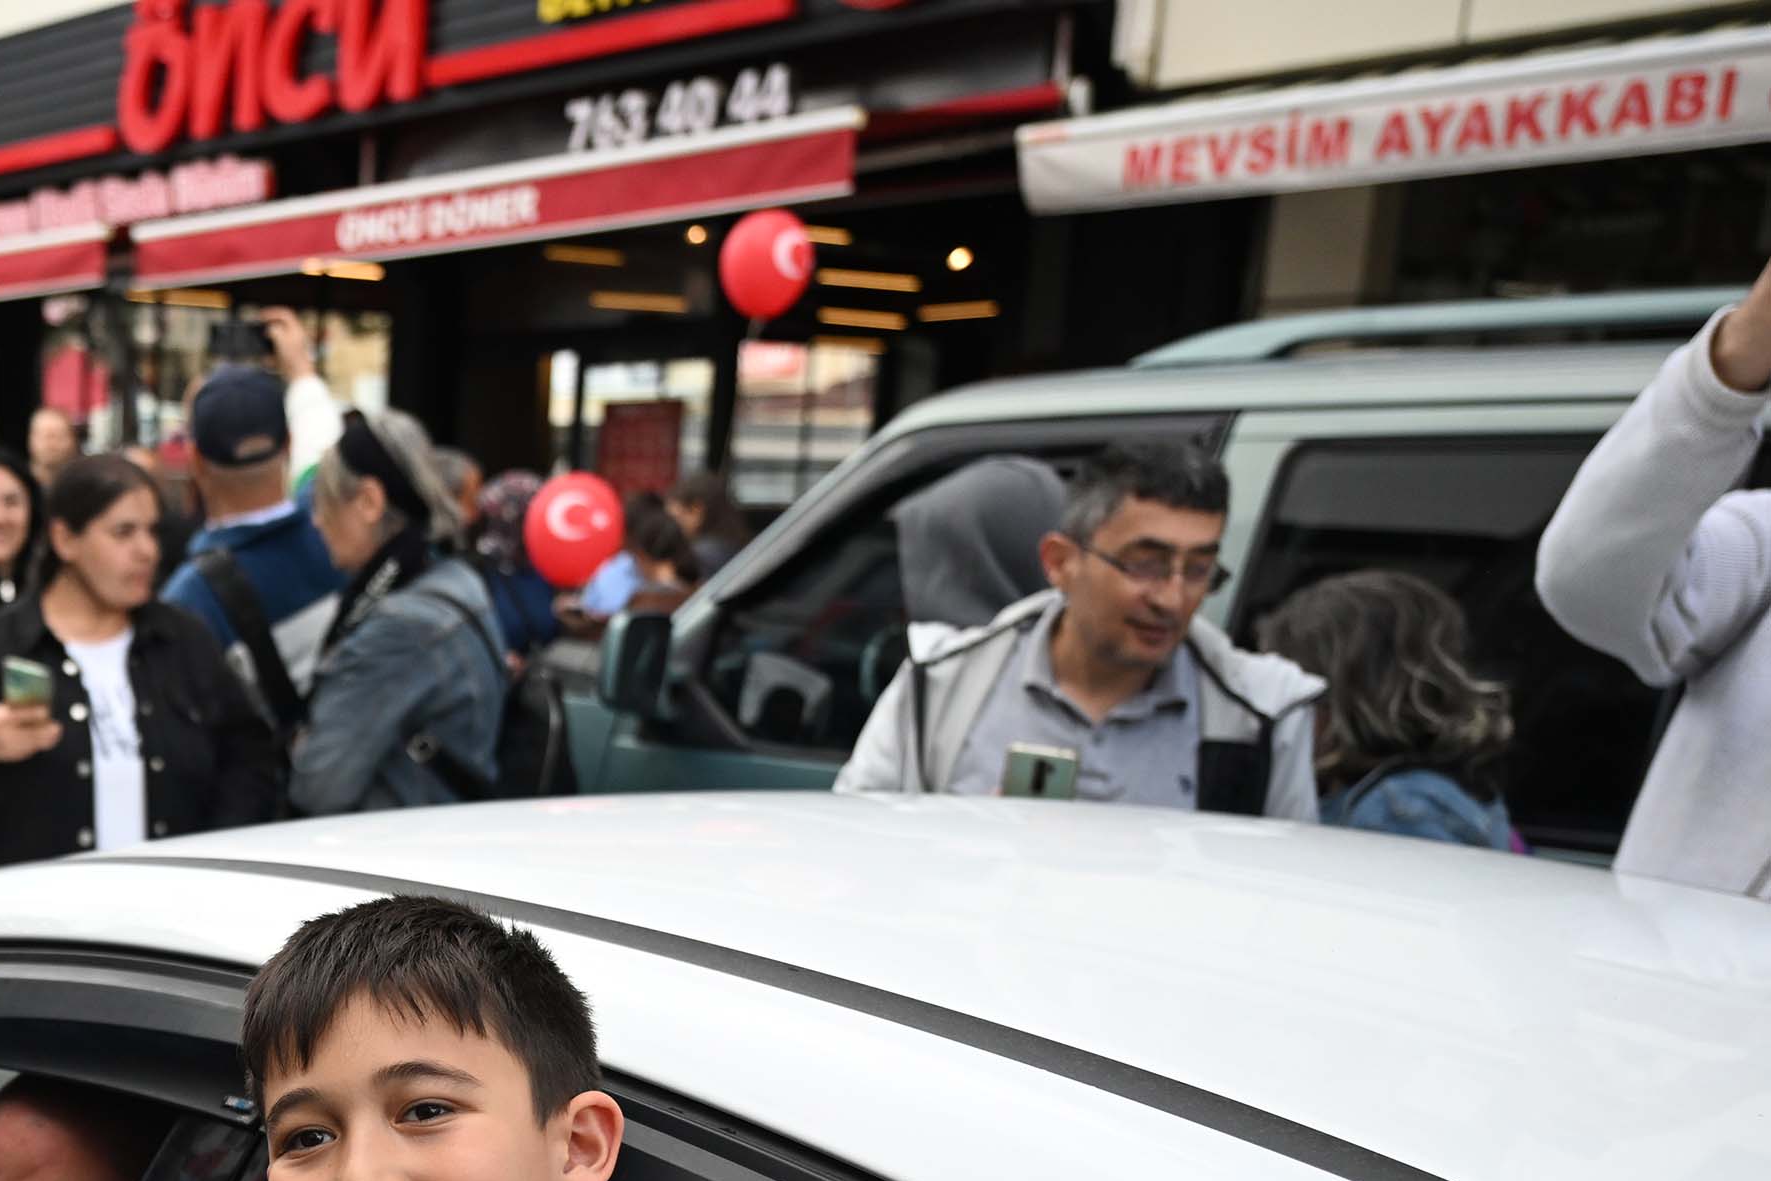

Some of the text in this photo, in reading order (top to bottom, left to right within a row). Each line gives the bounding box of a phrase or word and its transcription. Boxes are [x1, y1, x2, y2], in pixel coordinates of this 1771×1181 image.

[564, 62, 790, 151] 763 40 44
[1121, 65, 1739, 191] MEVSİM AYAKKABI
